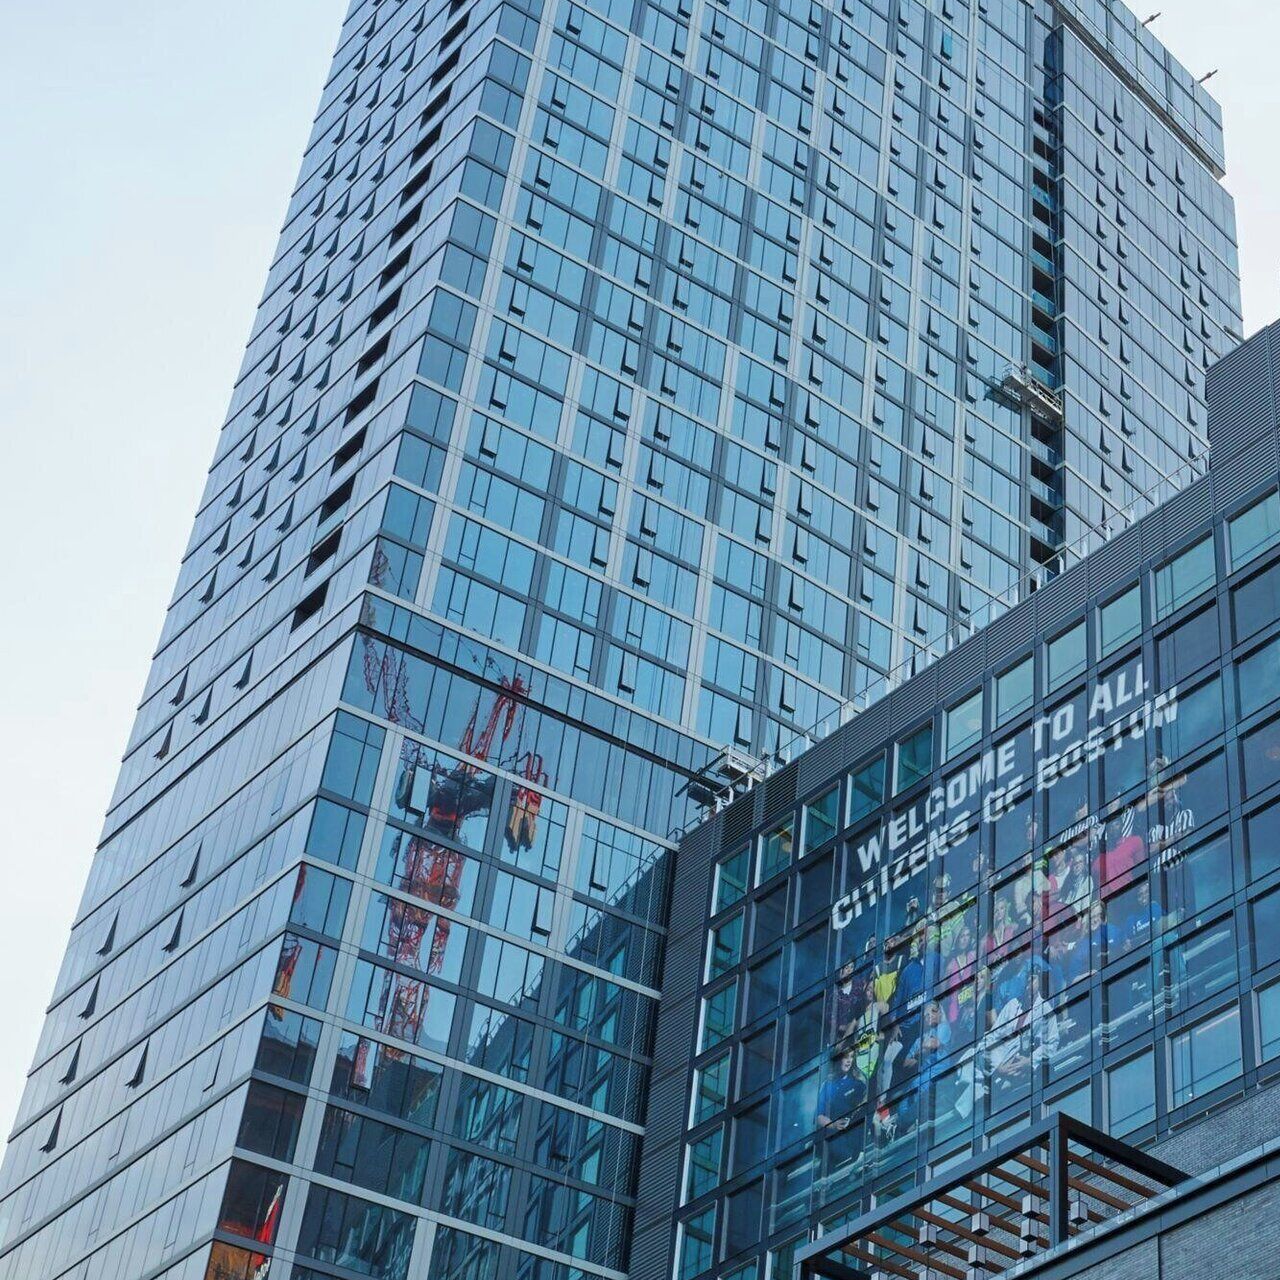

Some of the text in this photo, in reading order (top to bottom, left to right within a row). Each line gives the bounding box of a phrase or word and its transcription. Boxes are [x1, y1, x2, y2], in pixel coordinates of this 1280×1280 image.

[831, 685, 1179, 930] CITIZENS OF BOSTON
[857, 664, 1149, 872] WELCOME TO ALL
